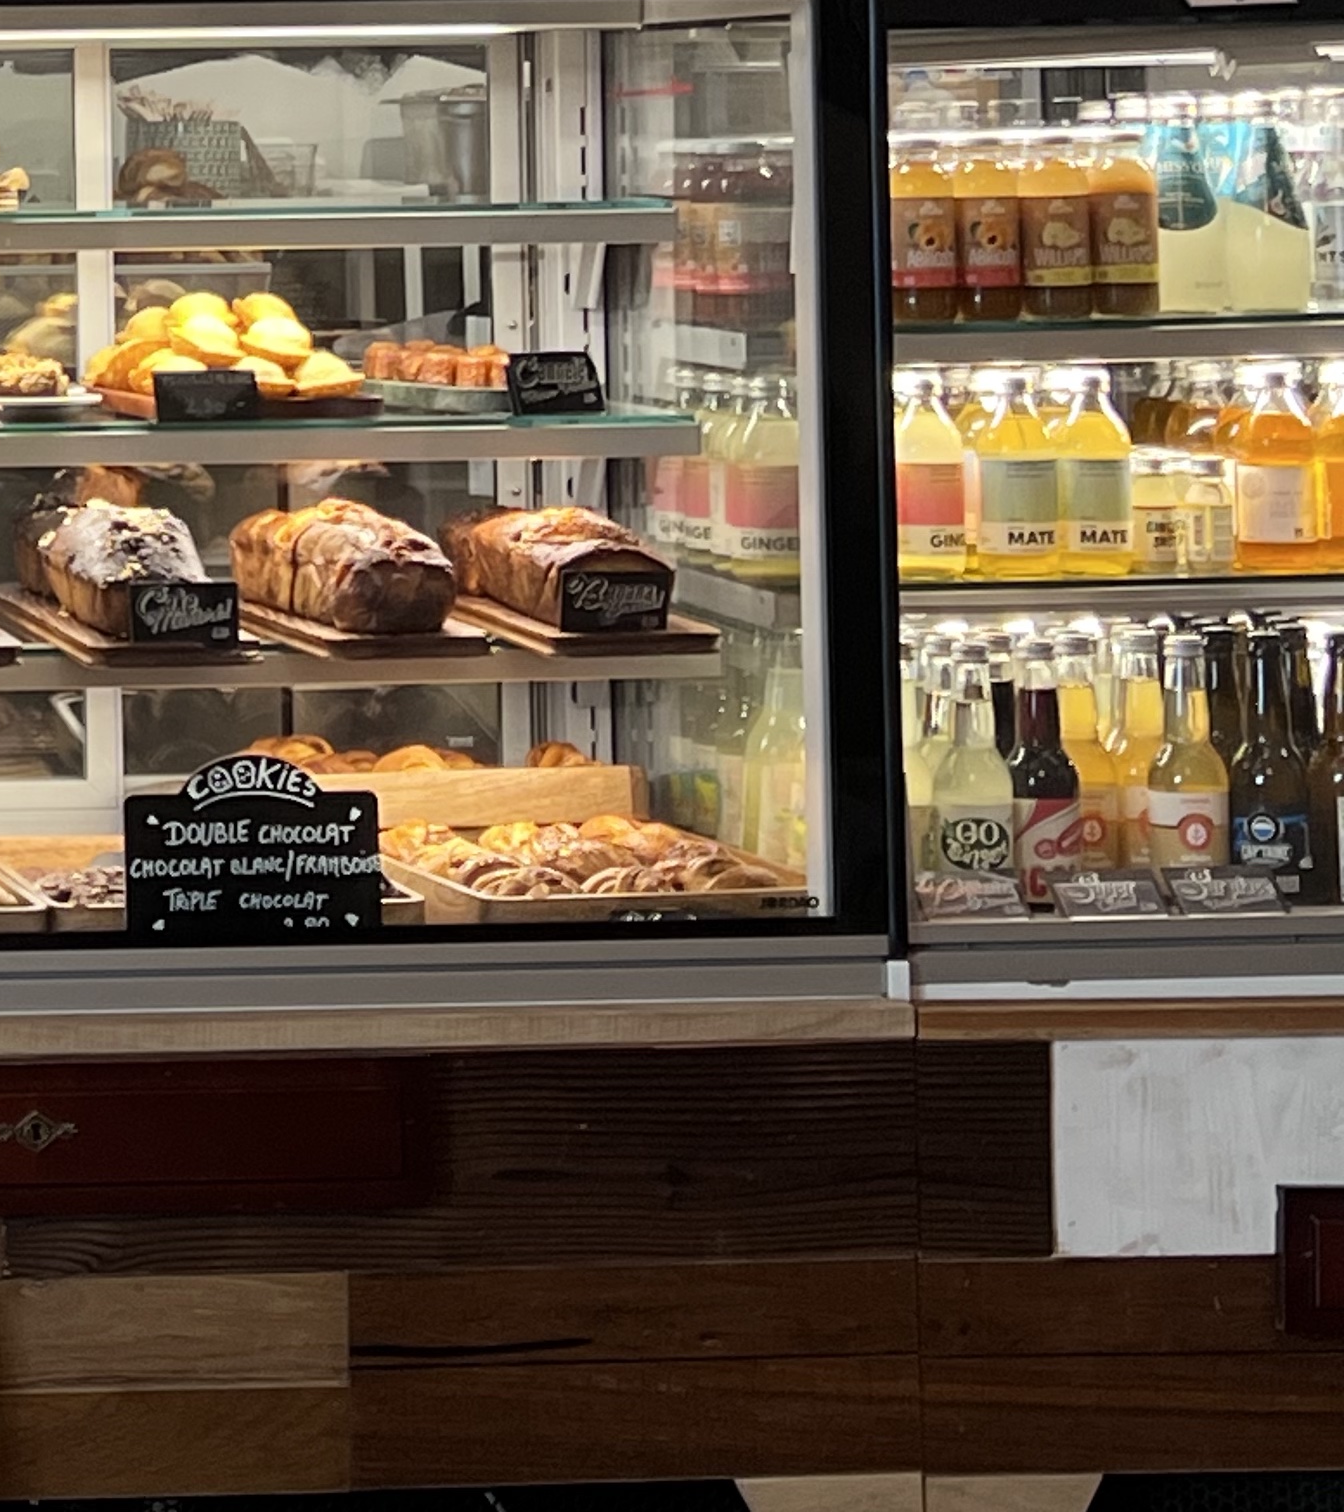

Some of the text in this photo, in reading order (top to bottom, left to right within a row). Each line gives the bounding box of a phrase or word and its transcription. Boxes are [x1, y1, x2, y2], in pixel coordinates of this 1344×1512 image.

[1007, 529, 1055, 545] MATE
[1080, 529, 1128, 544] MATE
[163, 819, 356, 846] DOUBLE CHOCOLAT
[130, 858, 225, 879] CHOCOLAT
[163, 887, 330, 911] TRIPLE CHOCOLAT
